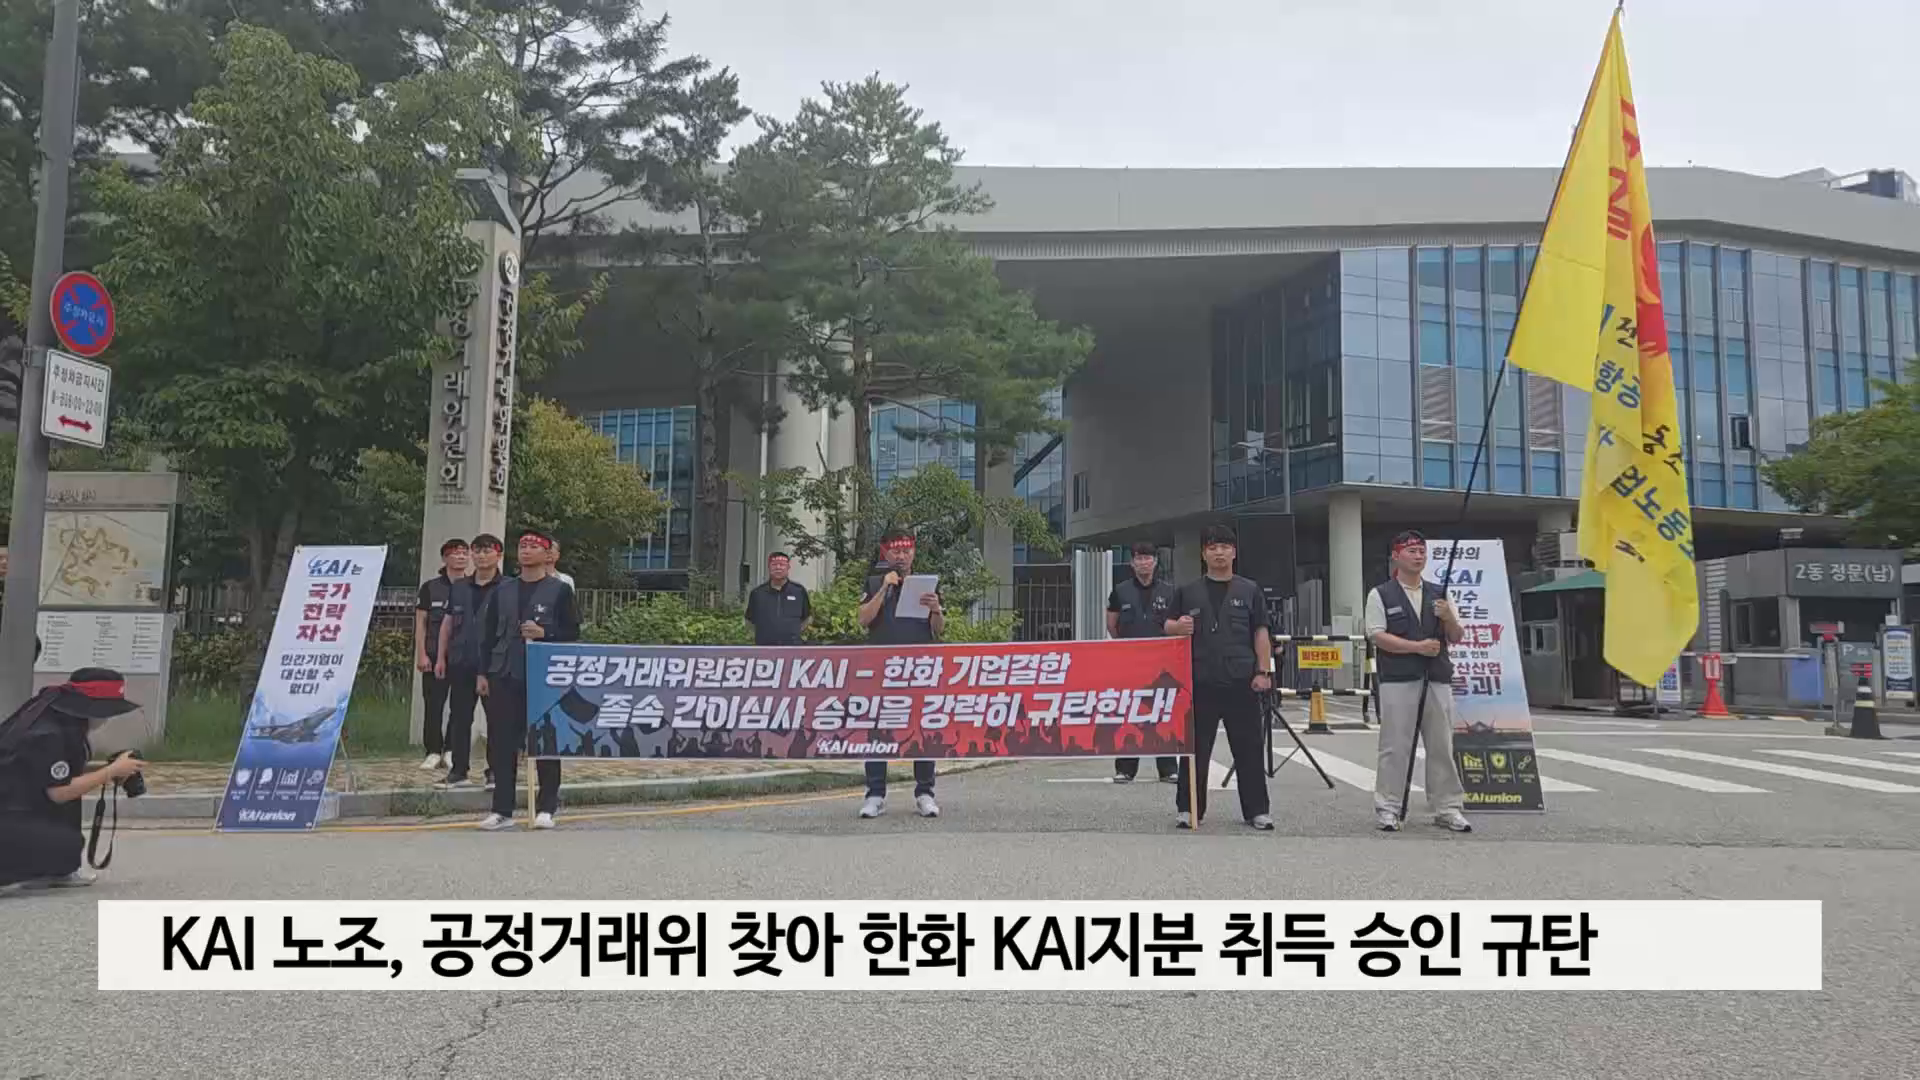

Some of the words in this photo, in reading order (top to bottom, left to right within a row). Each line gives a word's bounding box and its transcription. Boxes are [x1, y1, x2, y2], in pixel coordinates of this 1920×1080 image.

[1795, 563, 1824, 581] 2동
[1828, 562, 1895, 583] 정문(남)
[308, 583, 351, 600] 국가
[303, 603, 347, 621] 전략
[296, 624, 341, 642] 자산
[280, 653, 344, 667] 민간기업이
[1452, 661, 1502, 676] 산산업
[280, 668, 319, 681] 대신할
[323, 668, 335, 681] 수
[545, 655, 781, 689] 공정거래위원회의
[788, 657, 848, 689] KAI
[881, 655, 943, 688] 한화
[948, 651, 1071, 687] 기업결합
[289, 682, 320, 695] 없다!
[596, 693, 665, 729] 졸속
[671, 694, 805, 730] 간이심사
[811, 694, 912, 730] 승인을
[919, 691, 1022, 729] 강력히
[1027, 687, 1177, 726] 규탄한다!
